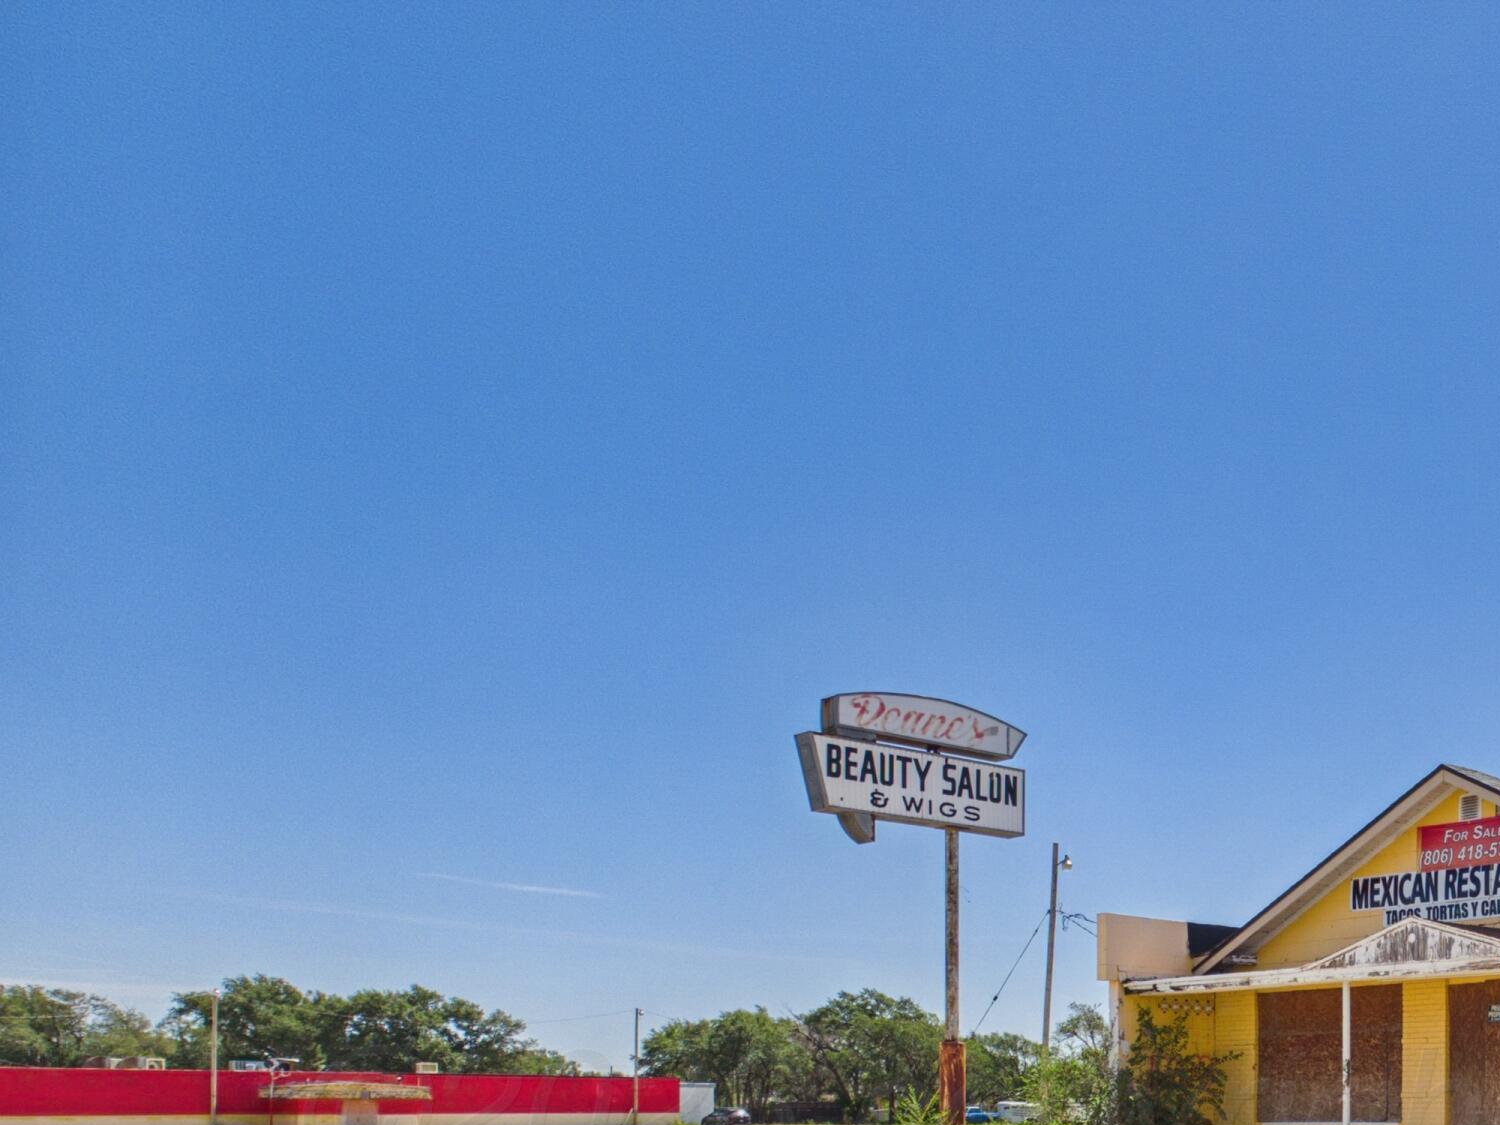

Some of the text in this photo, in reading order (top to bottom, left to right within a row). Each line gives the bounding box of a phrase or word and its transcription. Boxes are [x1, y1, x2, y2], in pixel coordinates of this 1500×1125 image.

[826, 743, 932, 792] BEAUTY
[941, 763, 1018, 807] SALON
[870, 788, 981, 822] & WIGS
[1418, 846, 1454, 867] (806)
[1351, 869, 1439, 910] MEXICAN
[1425, 902, 1469, 922] TORTAS
[1471, 901, 1479, 917] Y
